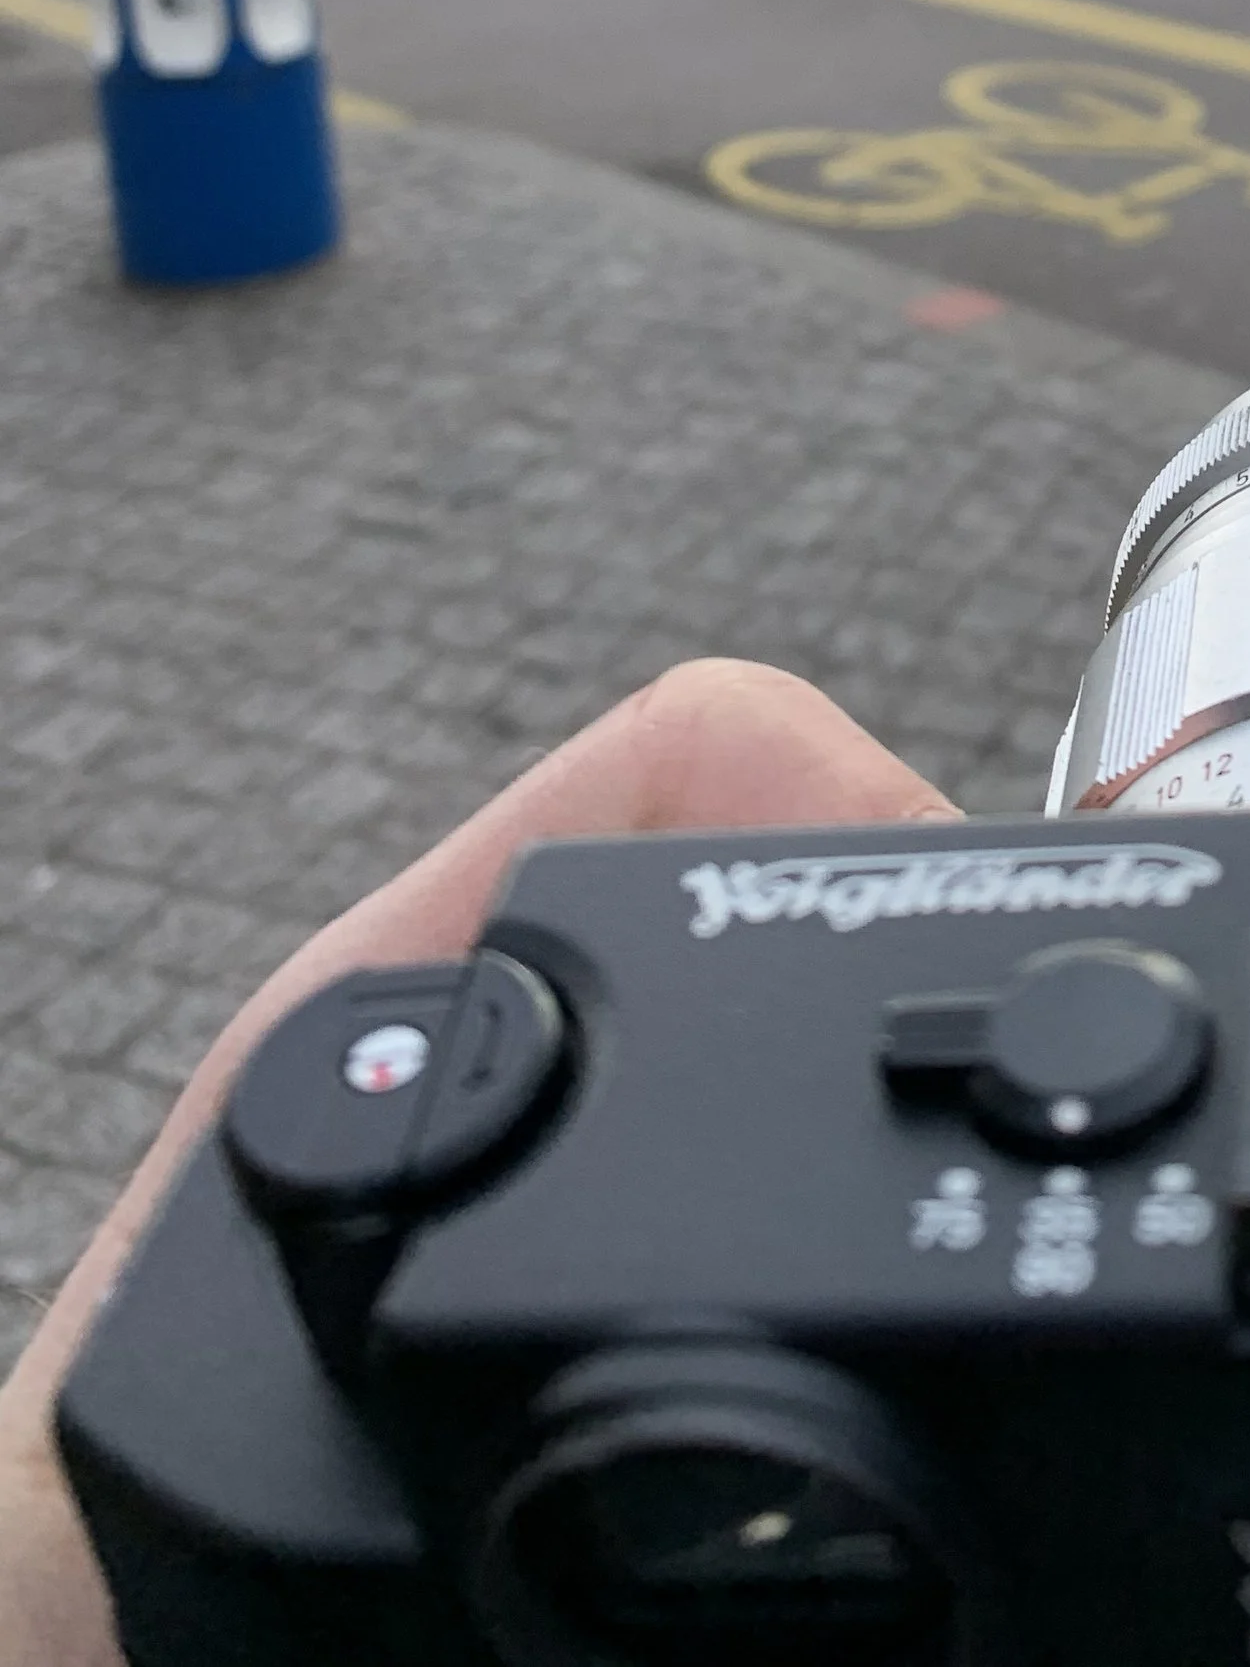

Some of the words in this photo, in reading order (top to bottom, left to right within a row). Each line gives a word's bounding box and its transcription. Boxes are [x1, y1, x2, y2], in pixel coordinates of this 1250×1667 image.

[1156, 775, 1184, 809] 10
[1203, 753, 1233, 781] 12
[1226, 784, 1246, 809] 4
